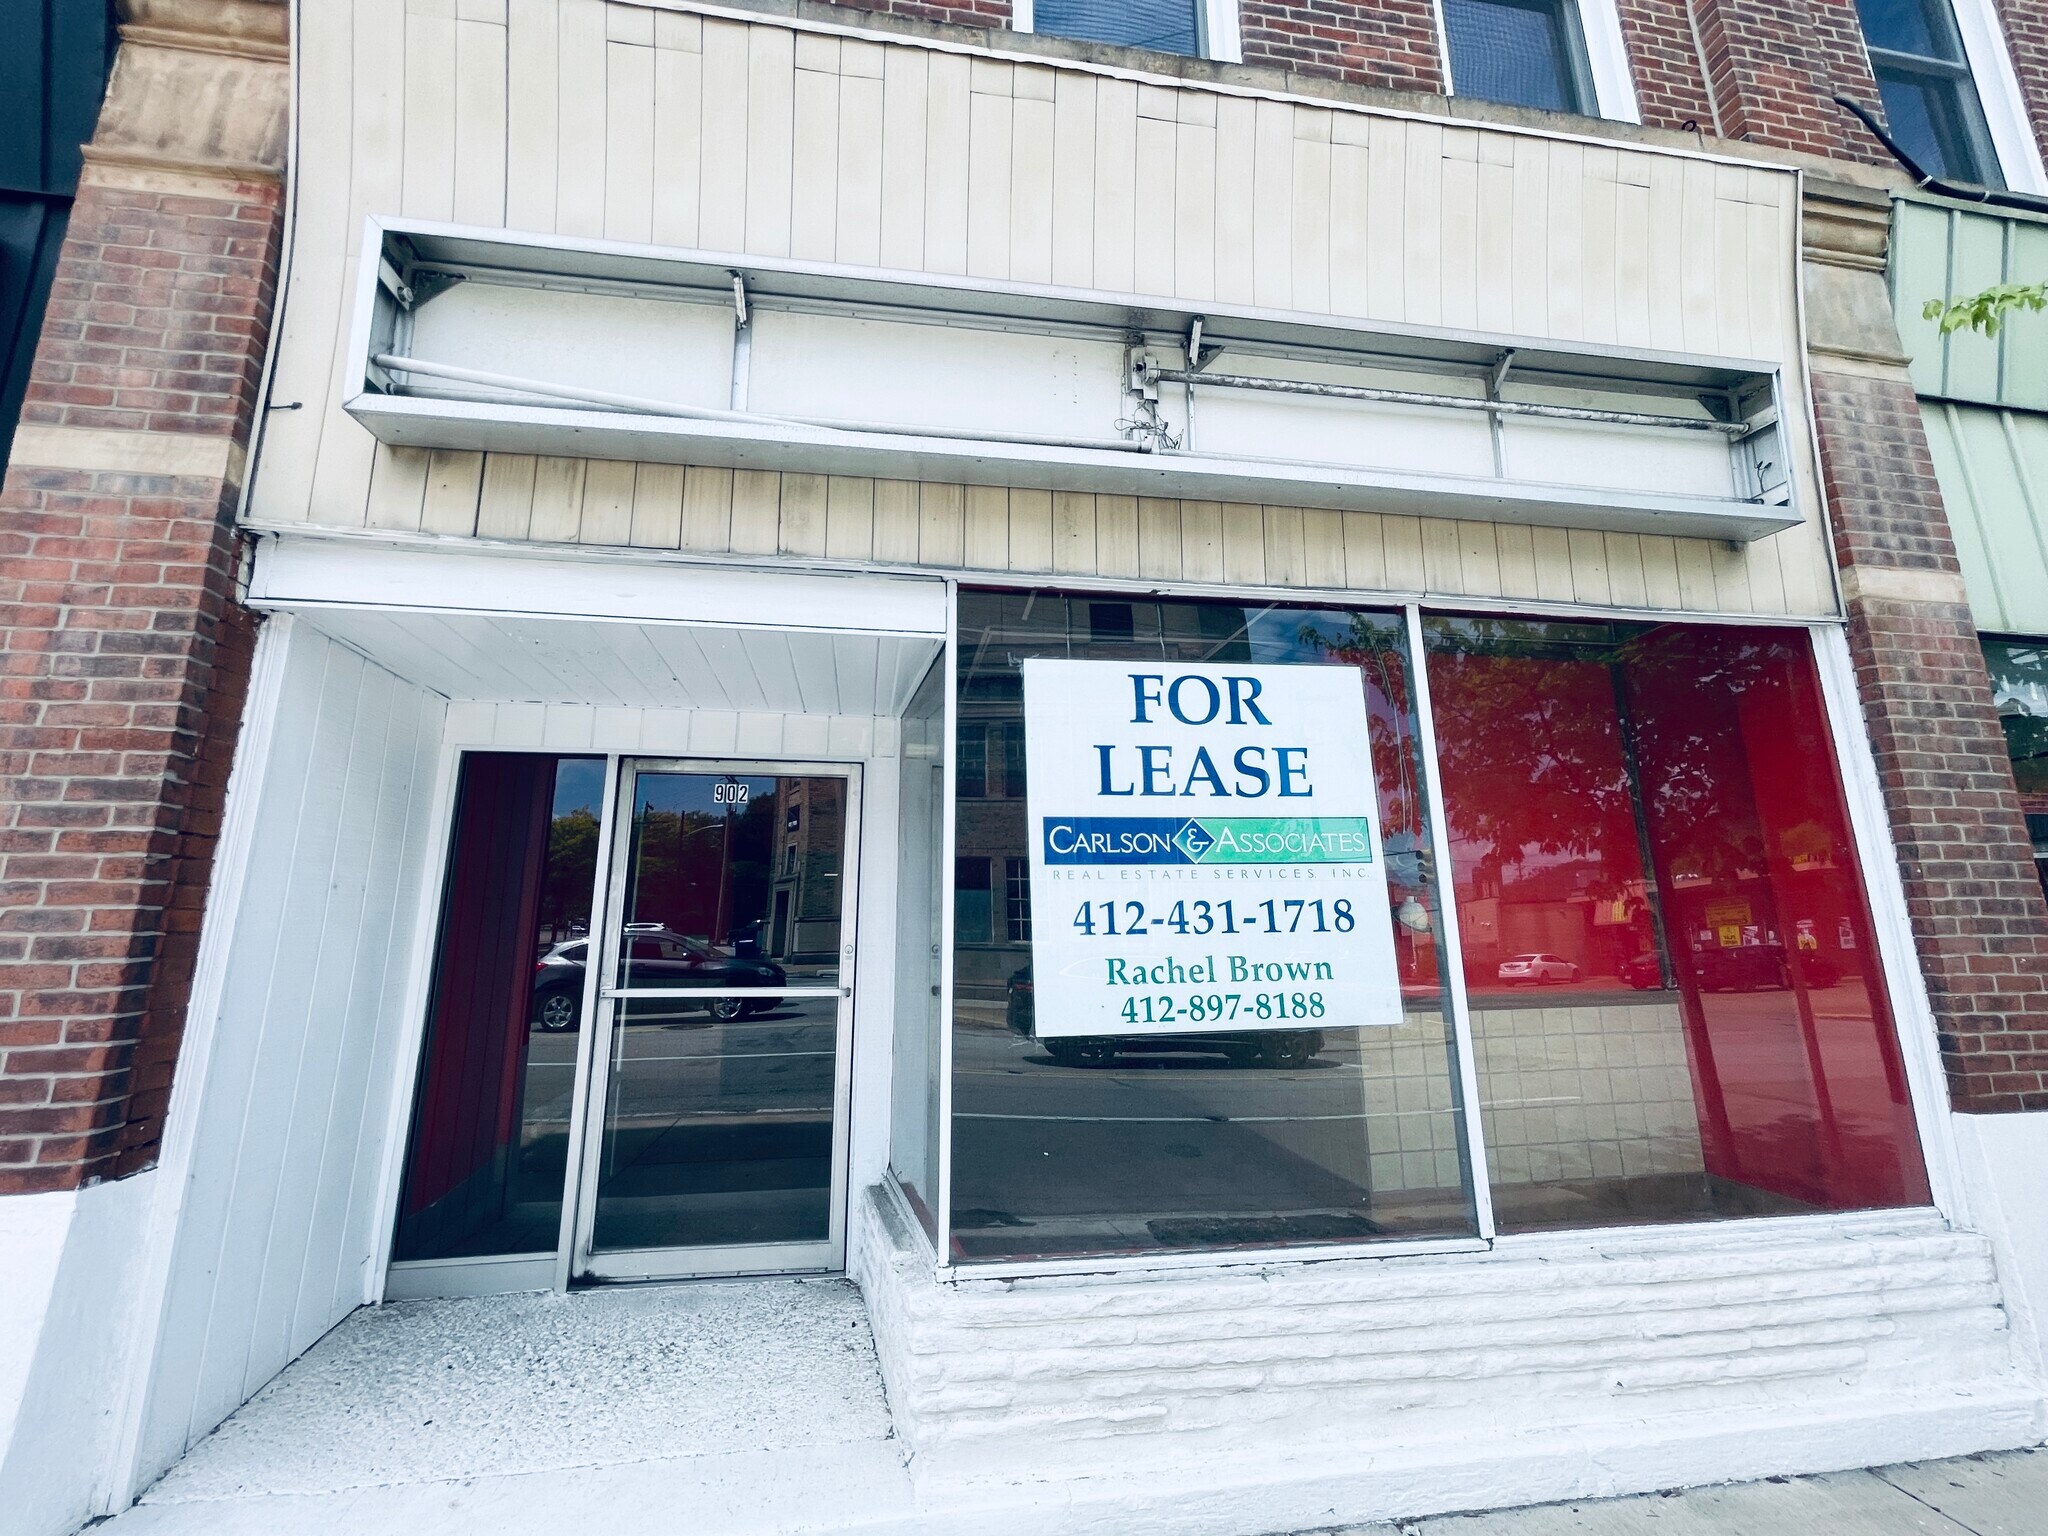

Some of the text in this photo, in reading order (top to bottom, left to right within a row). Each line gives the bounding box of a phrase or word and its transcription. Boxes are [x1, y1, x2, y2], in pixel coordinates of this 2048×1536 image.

[1128, 674, 1272, 725] FOR
[1093, 745, 1313, 797] LEASE
[715, 785, 748, 802] 902
[1186, 828, 1209, 853] &
[1053, 870, 1105, 880] REAL
[1120, 869, 1198, 880] ESTATE
[1332, 868, 1370, 879] INC.
[1072, 898, 1356, 936] 412-431-1718
[1105, 955, 1334, 986] Rachel Brown
[1120, 992, 1326, 1024] 412-897-8188
